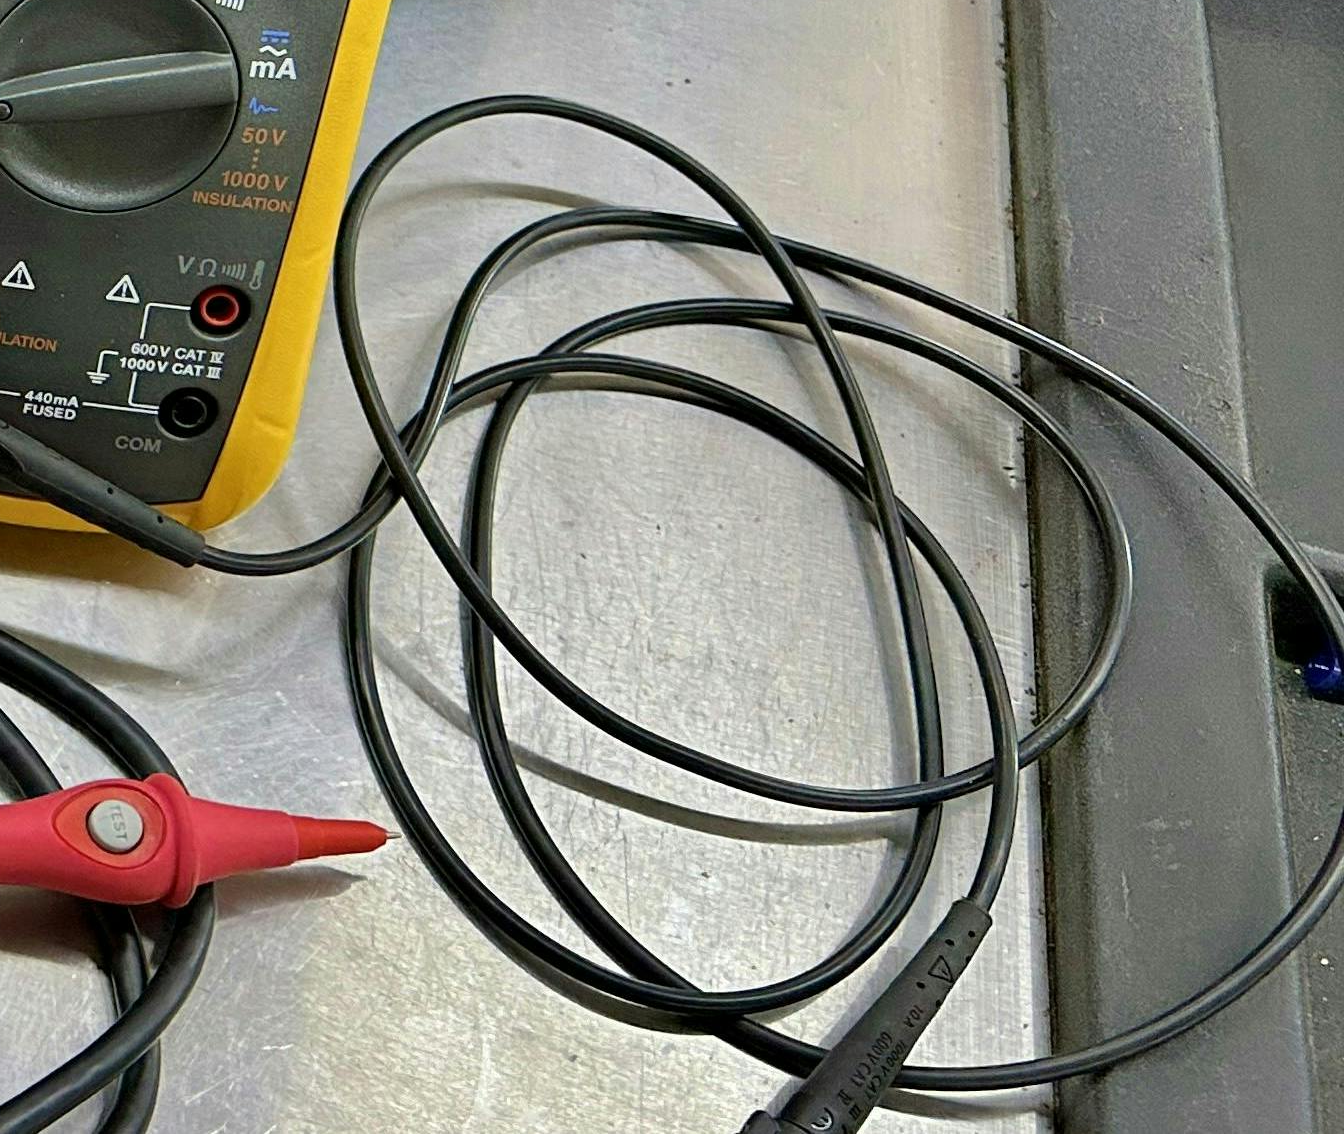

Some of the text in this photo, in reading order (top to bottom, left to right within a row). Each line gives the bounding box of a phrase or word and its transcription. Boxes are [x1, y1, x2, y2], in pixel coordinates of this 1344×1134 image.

[249, 57, 298, 80] mA
[242, 126, 286, 146] 50 V
[221, 170, 289, 193] 1000 V
[191, 190, 296, 214] INSULATION
[130, 341, 171, 359] 600V
[174, 345, 207, 362] CAT
[119, 357, 169, 373] 1000V
[171, 361, 204, 377] CAT
[23, 390, 80, 409] 440mA
[22, 403, 78, 421] FUSED
[114, 435, 162, 454] COM
[109, 803, 129, 843] TEST
